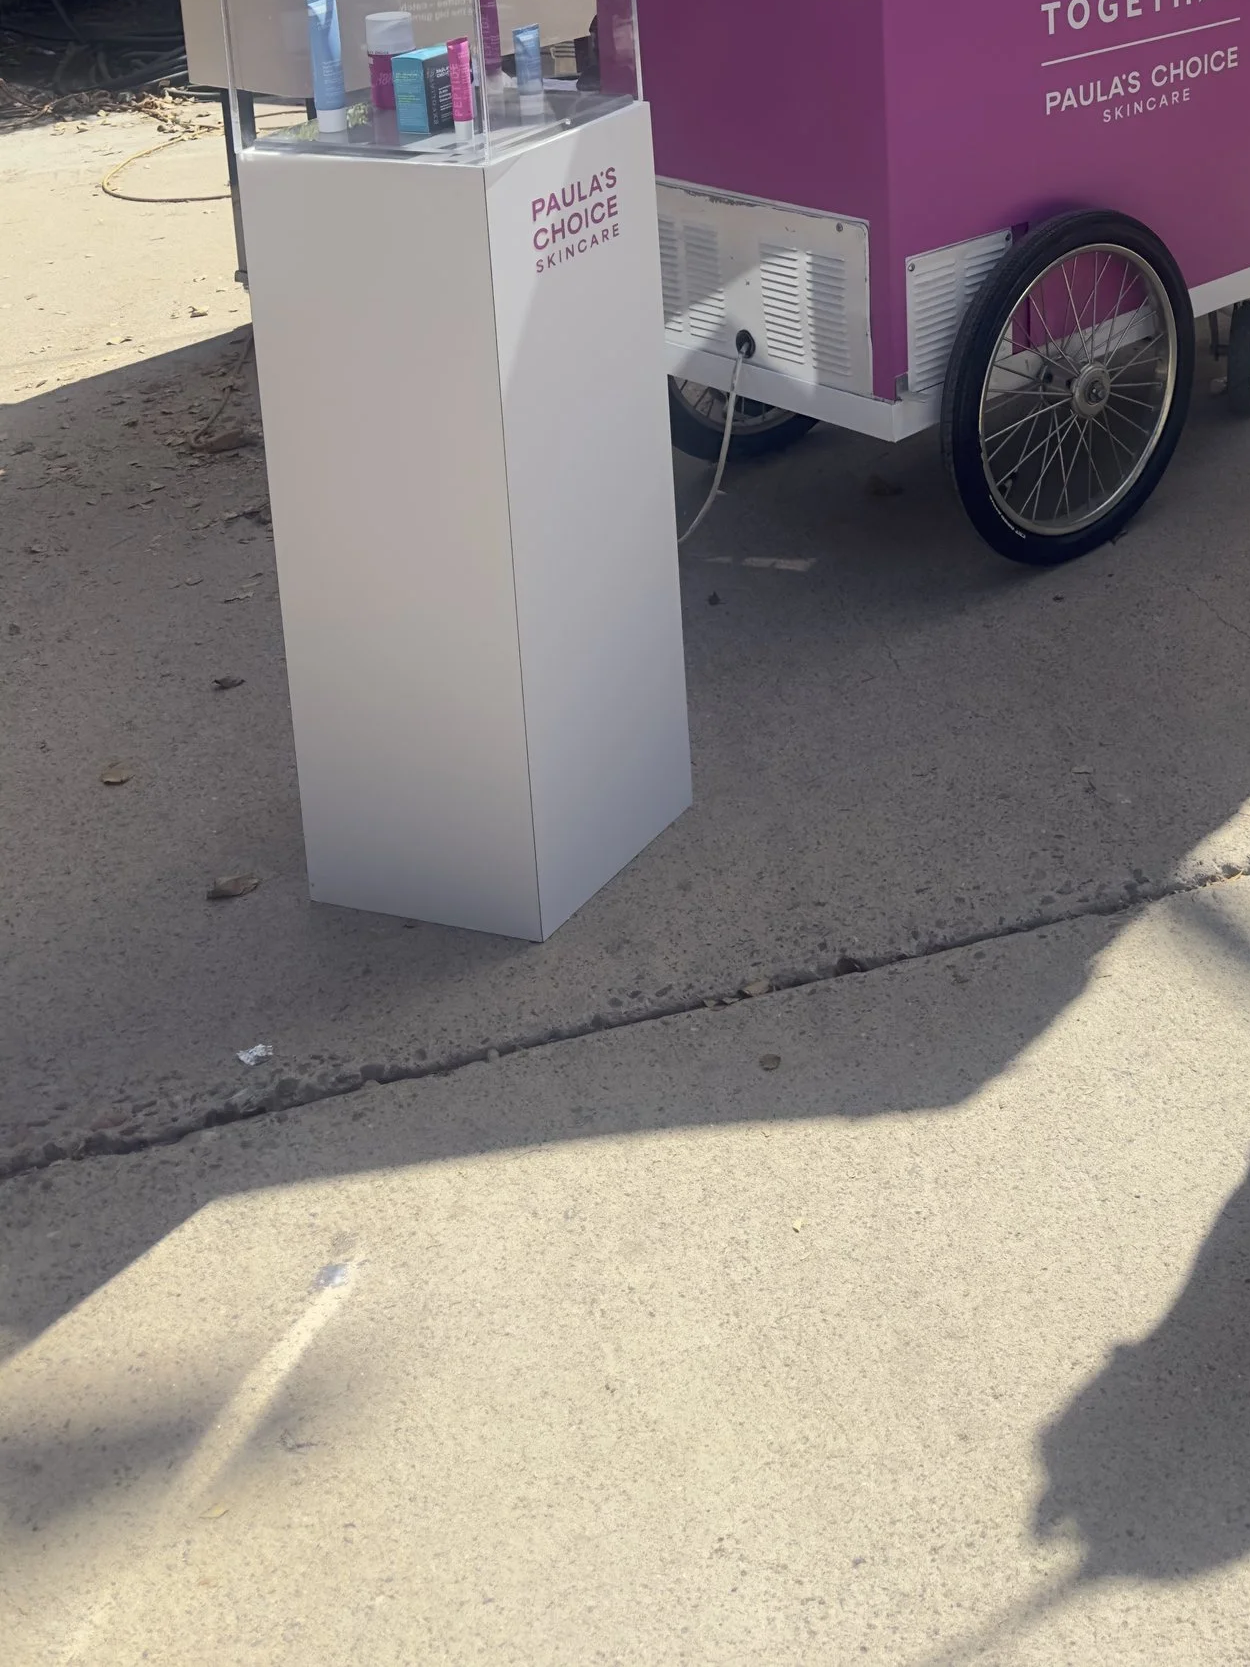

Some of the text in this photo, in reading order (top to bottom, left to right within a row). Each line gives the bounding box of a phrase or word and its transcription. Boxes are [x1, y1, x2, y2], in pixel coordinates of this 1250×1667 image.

[1046, 46, 1239, 115] PAULA'S CHOICE
[1102, 87, 1191, 123] SKINCARE
[531, 166, 617, 222] PAULA'S
[533, 194, 619, 251] CHOICE
[535, 222, 621, 274] SKINCARE
